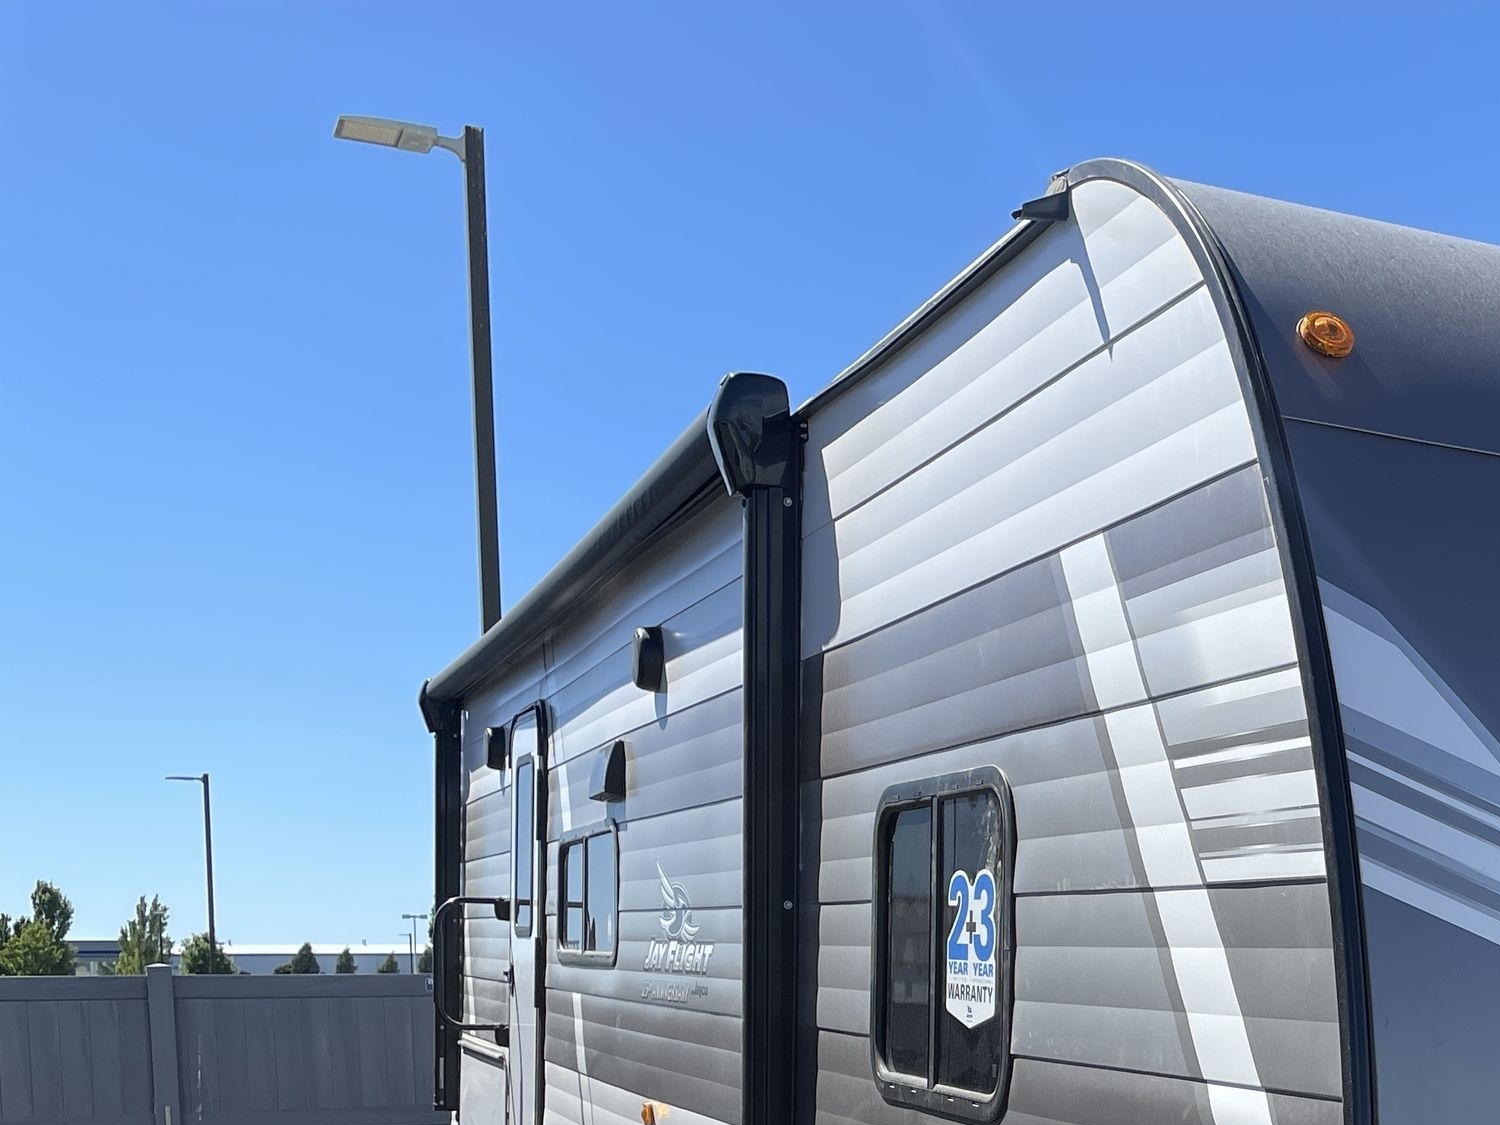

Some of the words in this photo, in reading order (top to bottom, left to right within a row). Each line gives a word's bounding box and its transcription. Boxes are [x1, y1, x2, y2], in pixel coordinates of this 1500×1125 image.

[643, 939, 668, 971] JAY
[665, 939, 714, 974] FLIGHT
[949, 961, 968, 976] YEAR
[973, 963, 993, 978] YEAR
[948, 982, 993, 1004] WARRANTY
